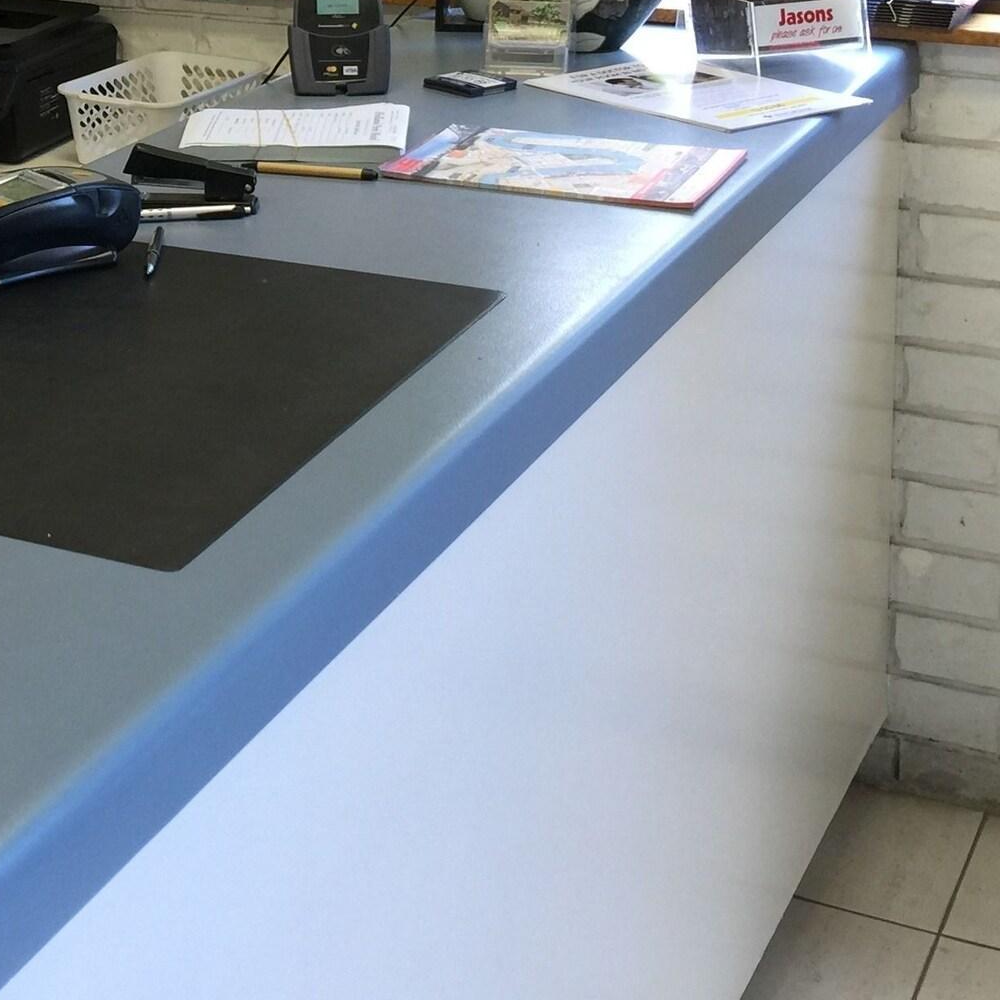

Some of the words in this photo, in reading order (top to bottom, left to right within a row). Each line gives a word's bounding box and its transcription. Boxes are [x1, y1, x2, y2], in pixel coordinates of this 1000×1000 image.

[779, 8, 834, 26] Jasons
[770, 28, 798, 42] please
[799, 26, 816, 37] ask
